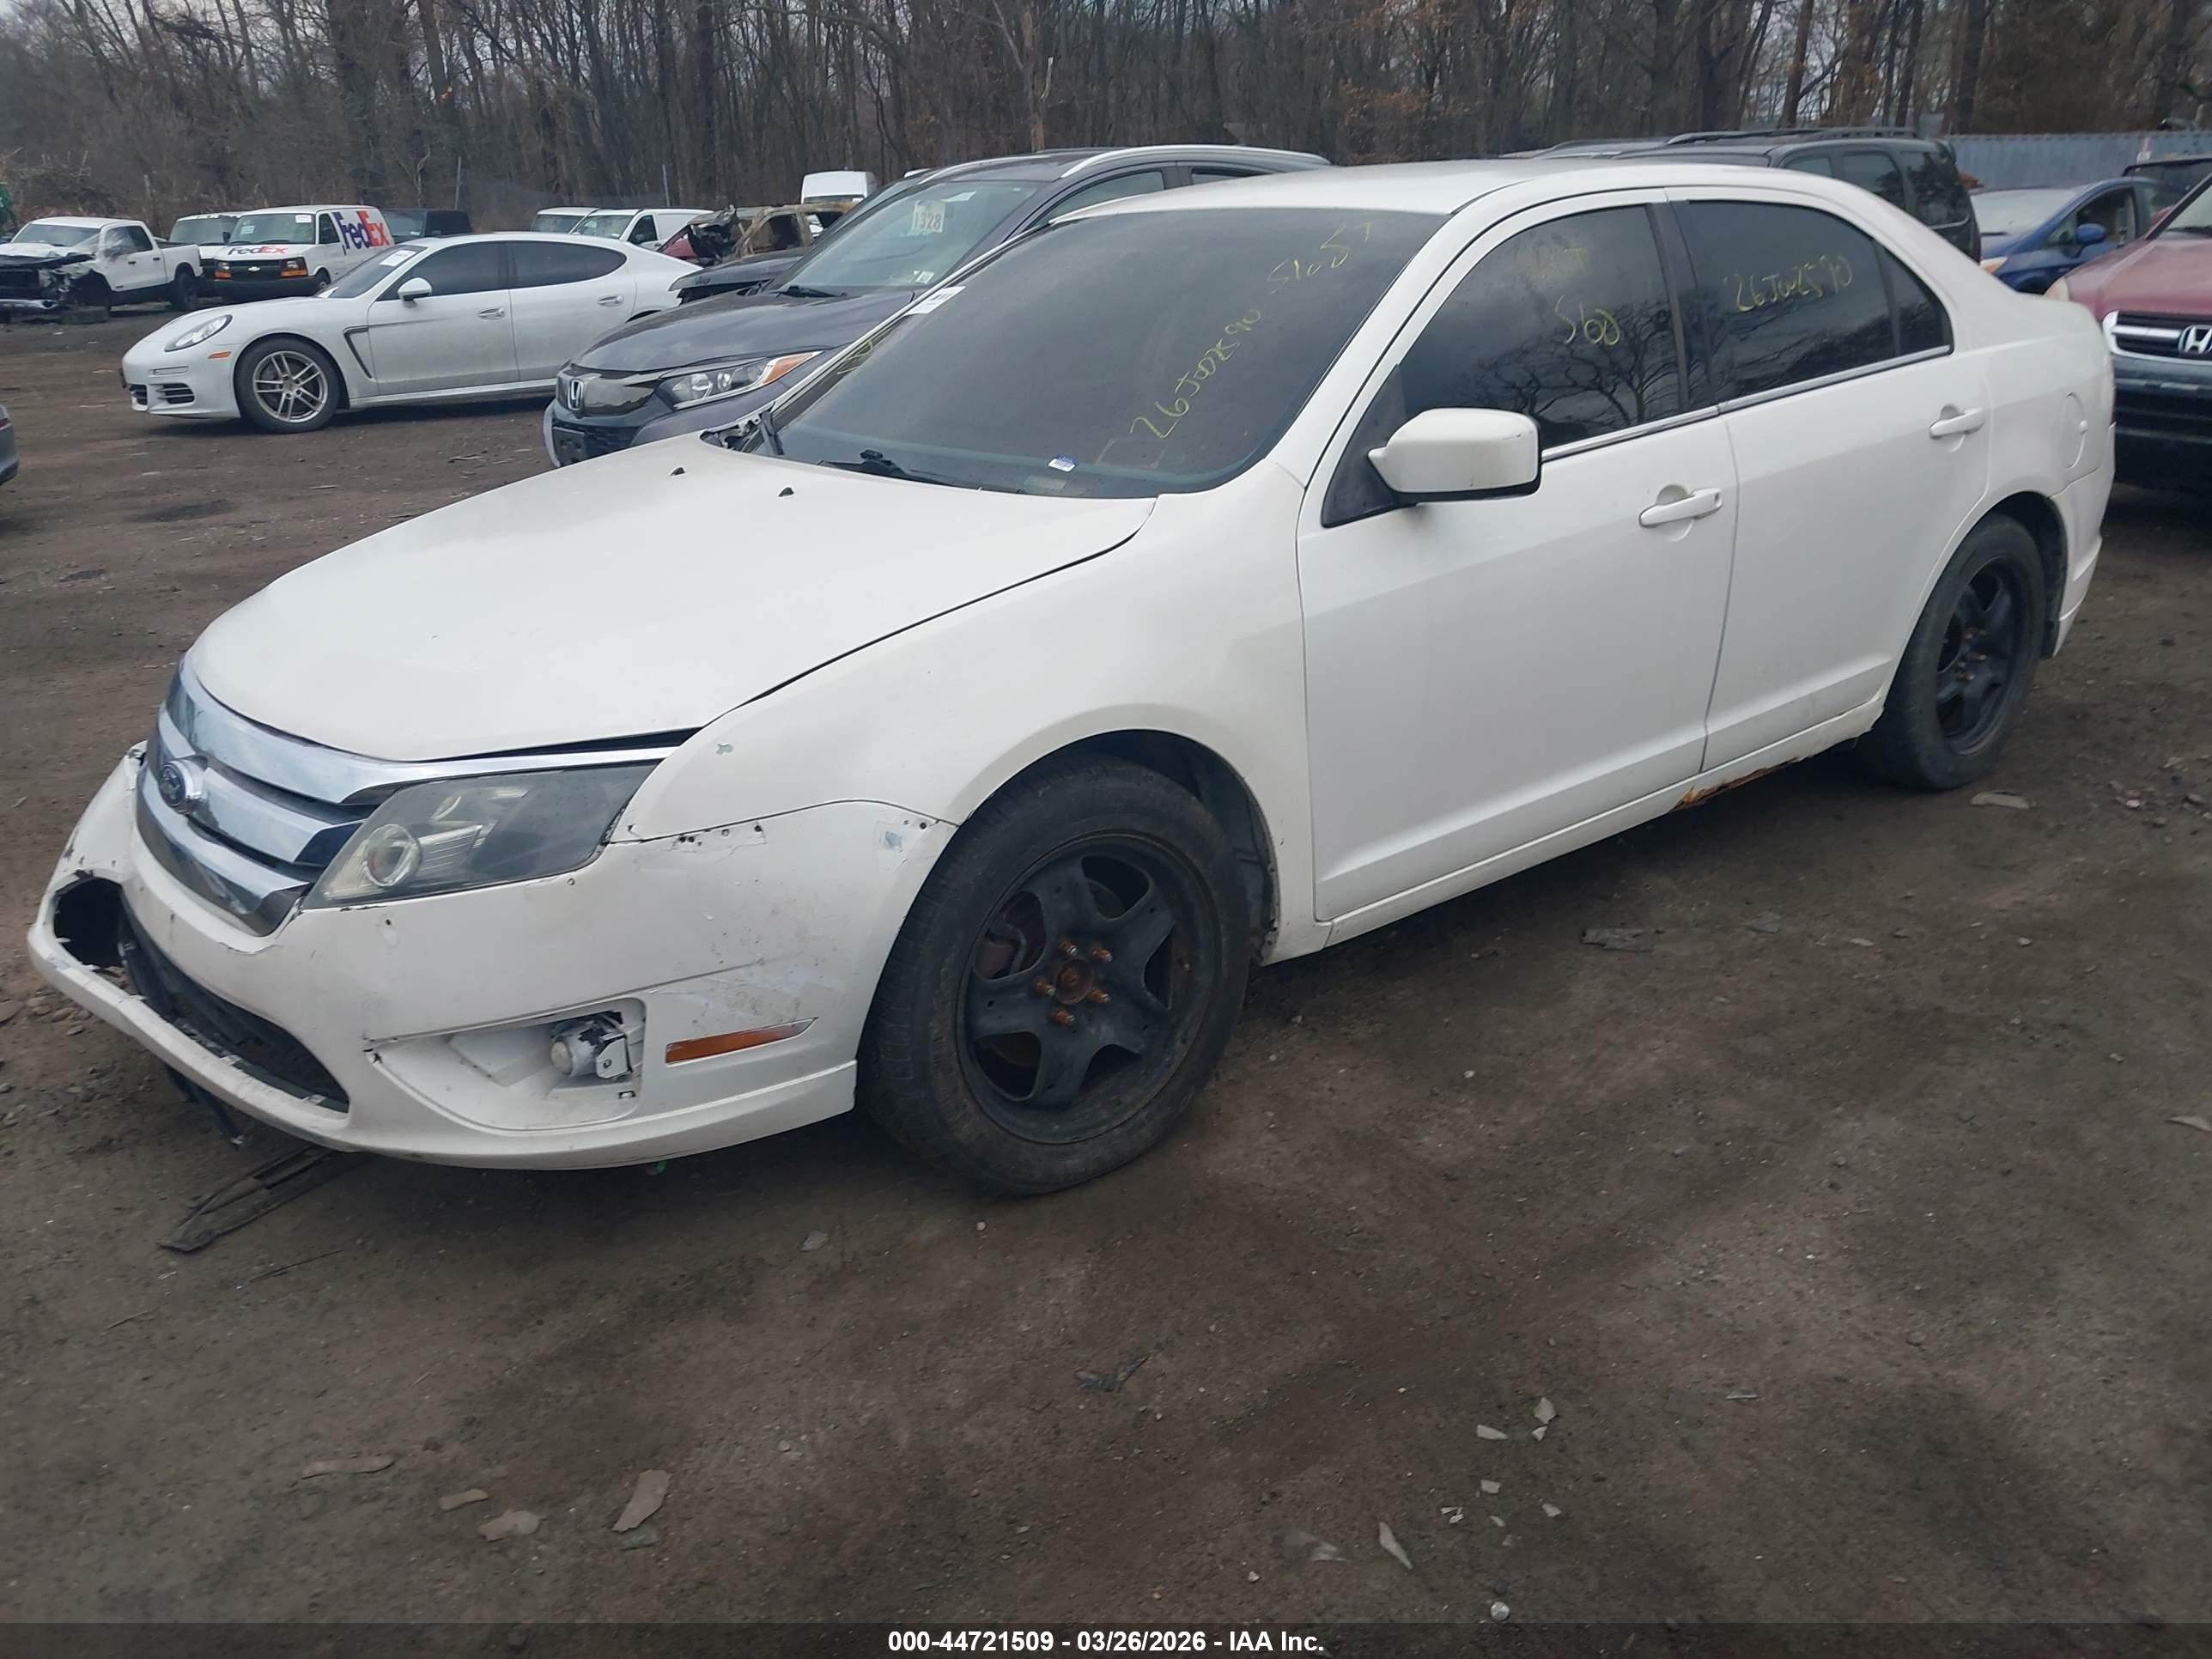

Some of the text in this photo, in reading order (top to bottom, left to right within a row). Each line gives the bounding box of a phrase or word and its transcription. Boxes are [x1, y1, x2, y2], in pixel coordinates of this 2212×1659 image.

[914, 212, 942, 231] 1328
[331, 211, 391, 256] FedEx
[227, 246, 288, 255] FedEx
